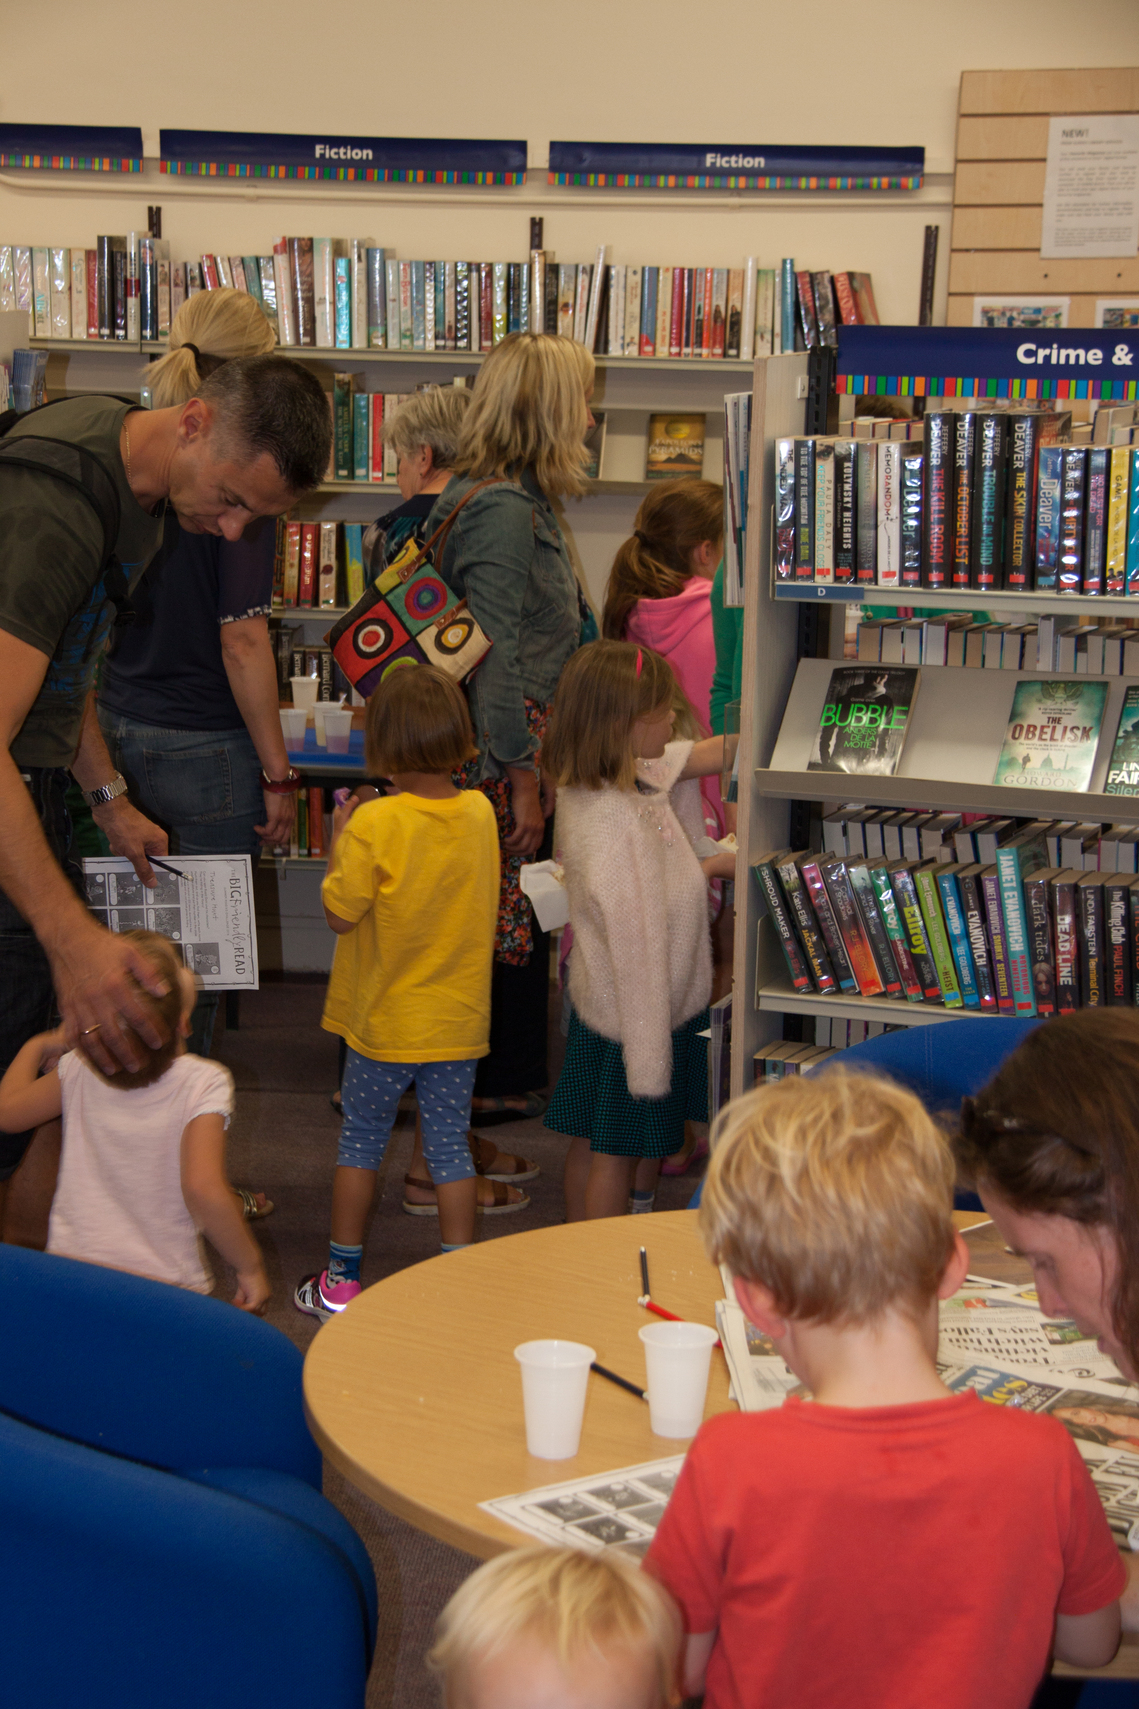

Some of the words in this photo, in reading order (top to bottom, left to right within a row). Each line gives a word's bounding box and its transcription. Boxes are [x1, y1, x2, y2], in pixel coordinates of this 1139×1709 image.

[314, 143, 373, 161] Fiction
[705, 152, 766, 169] Fiction
[1016, 343, 1103, 366] Crime
[1111, 344, 1135, 367] &
[930, 421, 941, 466] DEAVER
[941, 425, 949, 455] JEFFERY
[956, 422, 968, 467] DEAVER
[981, 422, 995, 467] DEAVER
[993, 426, 1001, 456] JEFFERY
[1012, 423, 1025, 469] DEAVER
[1024, 427, 1033, 458] JEFFERY
[816, 465, 825, 484] KEEP
[842, 462, 852, 508] KOLYMSKY
[883, 446, 892, 516] MEMORANDOM
[932, 468, 945, 490] THE
[959, 470, 969, 485] THE
[1015, 471, 1027, 489] THE
[1065, 457, 1075, 496] DEAVER
[1097, 474, 1105, 486] NO
[1114, 475, 1123, 500] GAME
[816, 486, 825, 508] YOUR
[930, 492, 946, 522] KILL
[981, 469, 997, 523] TROUBLE
[1013, 490, 1028, 517] SKIN
[1038, 479, 1059, 530] Deaver
[1089, 490, 1097, 513] DEAD
[1096, 487, 1104, 508] REST
[902, 488, 921, 538] Deaver
[956, 486, 970, 536] OCTOBER
[1064, 506, 1076, 538] EMPTY
[1095, 509, 1103, 526] FOR
[816, 509, 825, 542] FRIENDS
[842, 511, 852, 549] HEIGHTS
[982, 524, 992, 535] IN
[930, 525, 945, 563] ROOM
[955, 537, 969, 565] LIST
[980, 536, 993, 566] MIND
[1012, 518, 1024, 566] COLLECTOR
[816, 543, 825, 569] CLOSE
[817, 588, 826, 597] D
[321, 653, 333, 683] Bernard
[820, 703, 909, 730] BUBBLE
[1047, 716, 1063, 725] THE
[842, 727, 877, 736] ANDERS
[843, 740, 873, 749] MOTTE
[850, 733, 863, 741] DE
[865, 733, 876, 742] LA
[1011, 723, 1095, 744] OBELISK
[1003, 775, 1078, 789] GORDON
[921, 876, 932, 891] Janet
[999, 855, 1016, 887] JANET
[208, 870, 217, 901] Treasure
[229, 878, 242, 898] BIG
[832, 883, 840, 891] of
[985, 880, 996, 899] JANET
[1112, 891, 1123, 902] The
[211, 904, 219, 922] Hunt
[761, 870, 778, 907] SHROUD
[773, 907, 790, 939] MAKER
[791, 891, 804, 910] Kate
[818, 895, 829, 910] Dark
[833, 891, 848, 921] Shadows
[840, 885, 854, 915] Carnival
[859, 893, 868, 907] and
[867, 918, 877, 934] River
[866, 894, 876, 908] The
[924, 891, 937, 918] Evanovich
[967, 893, 975, 909] JANET
[1086, 889, 1095, 914] LINDA
[225, 899, 247, 948] Friendly
[796, 910, 809, 926] Ellis
[822, 910, 833, 924] and
[931, 920, 939, 932] LEE
[947, 896, 961, 935] EVANOVICH
[988, 900, 1001, 934] EVANOVICH
[1004, 891, 1024, 952] EVANOVICH
[1032, 901, 1044, 928] dark
[1108, 901, 1126, 927] Killing
[809, 932, 817, 942] THE
[829, 925, 842, 948] Broken
[849, 929, 858, 943] R.J.
[903, 905, 927, 955] Ellroy
[967, 910, 986, 966] EVANOVICH
[1057, 915, 1071, 951] DEAD
[1087, 914, 1097, 955] FAIRSTEIN
[1110, 926, 1126, 945] Club
[801, 929, 817, 958] JACKAL
[811, 958, 823, 977] MAN
[836, 948, 848, 967] Heart
[853, 944, 868, 973] ELLORY
[877, 943, 887, 956] R.J.
[893, 933, 909, 971] CLANDESTINE
[933, 931, 945, 962] GOLDBERG
[956, 946, 964, 956] LEE
[993, 934, 1003, 962] SMOKIN'
[1034, 931, 1047, 961] tides
[1113, 945, 1123, 969] PAUL
[233, 947, 246, 975] READ
[790, 958, 801, 975] Ellis
[881, 957, 896, 982] ELLORY
[958, 956, 972, 985] GOLDBERG
[1019, 954, 1030, 995] NOTORIOUS
[1057, 954, 1072, 985] LINE
[1089, 957, 1099, 989] Terminal
[942, 970, 953, 992] HEIST
[997, 963, 1009, 997] SEVENTEEN
[1010, 960, 1020, 992] NINETEEN
[1113, 969, 1124, 996] FINCH
[1088, 989, 1100, 1006] City
